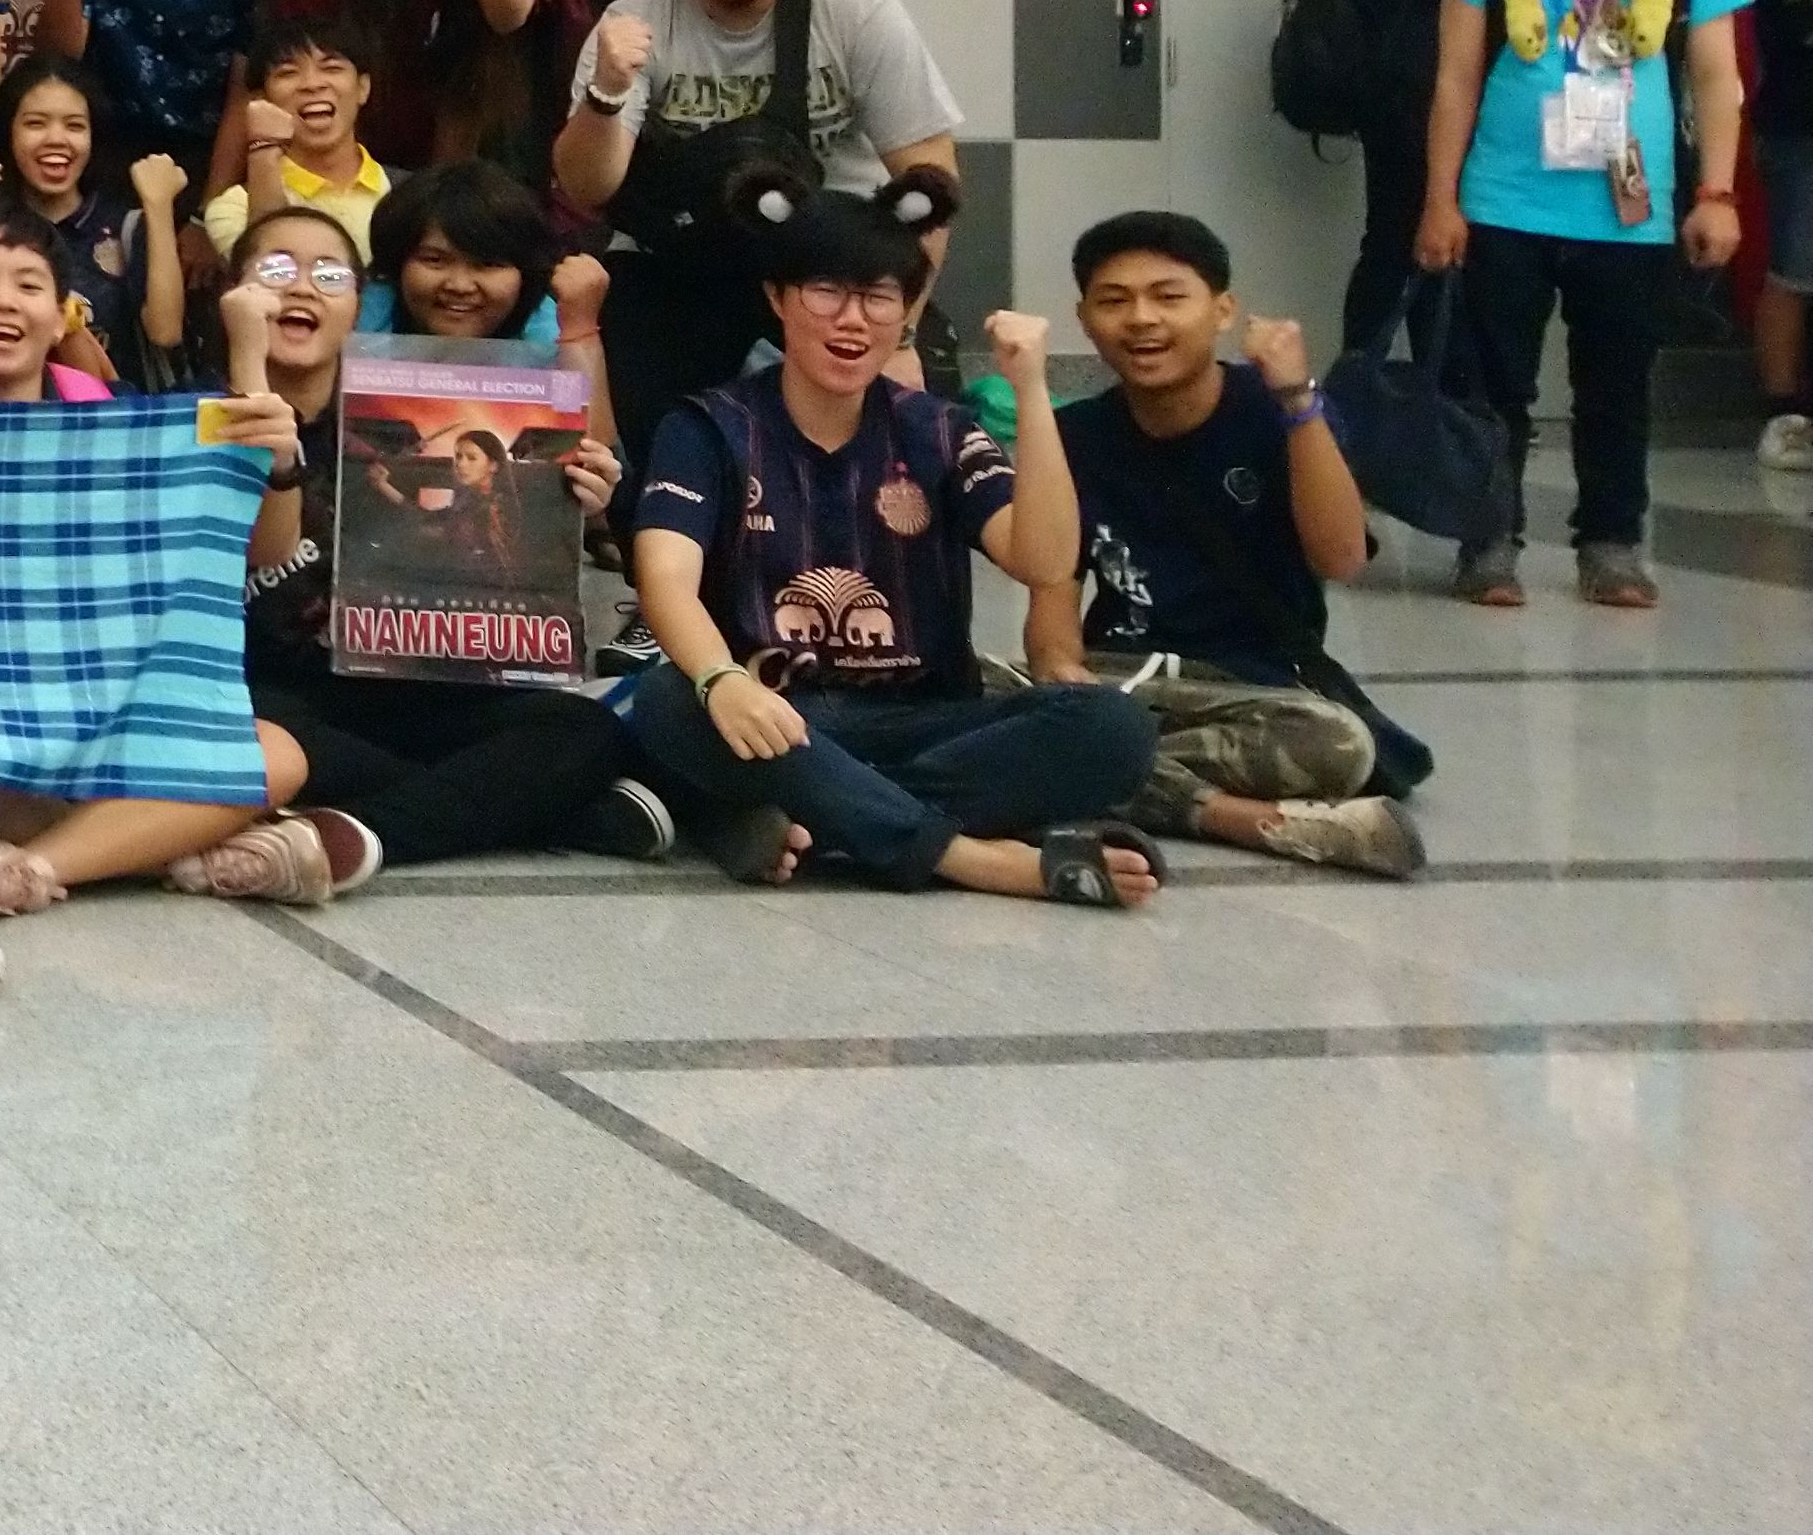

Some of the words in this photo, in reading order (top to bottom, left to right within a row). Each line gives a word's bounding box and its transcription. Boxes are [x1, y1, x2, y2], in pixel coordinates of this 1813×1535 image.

[418, 376, 478, 392] GENERAL
[481, 380, 547, 396] ELECTION
[345, 606, 573, 665] NAMNEUNG
